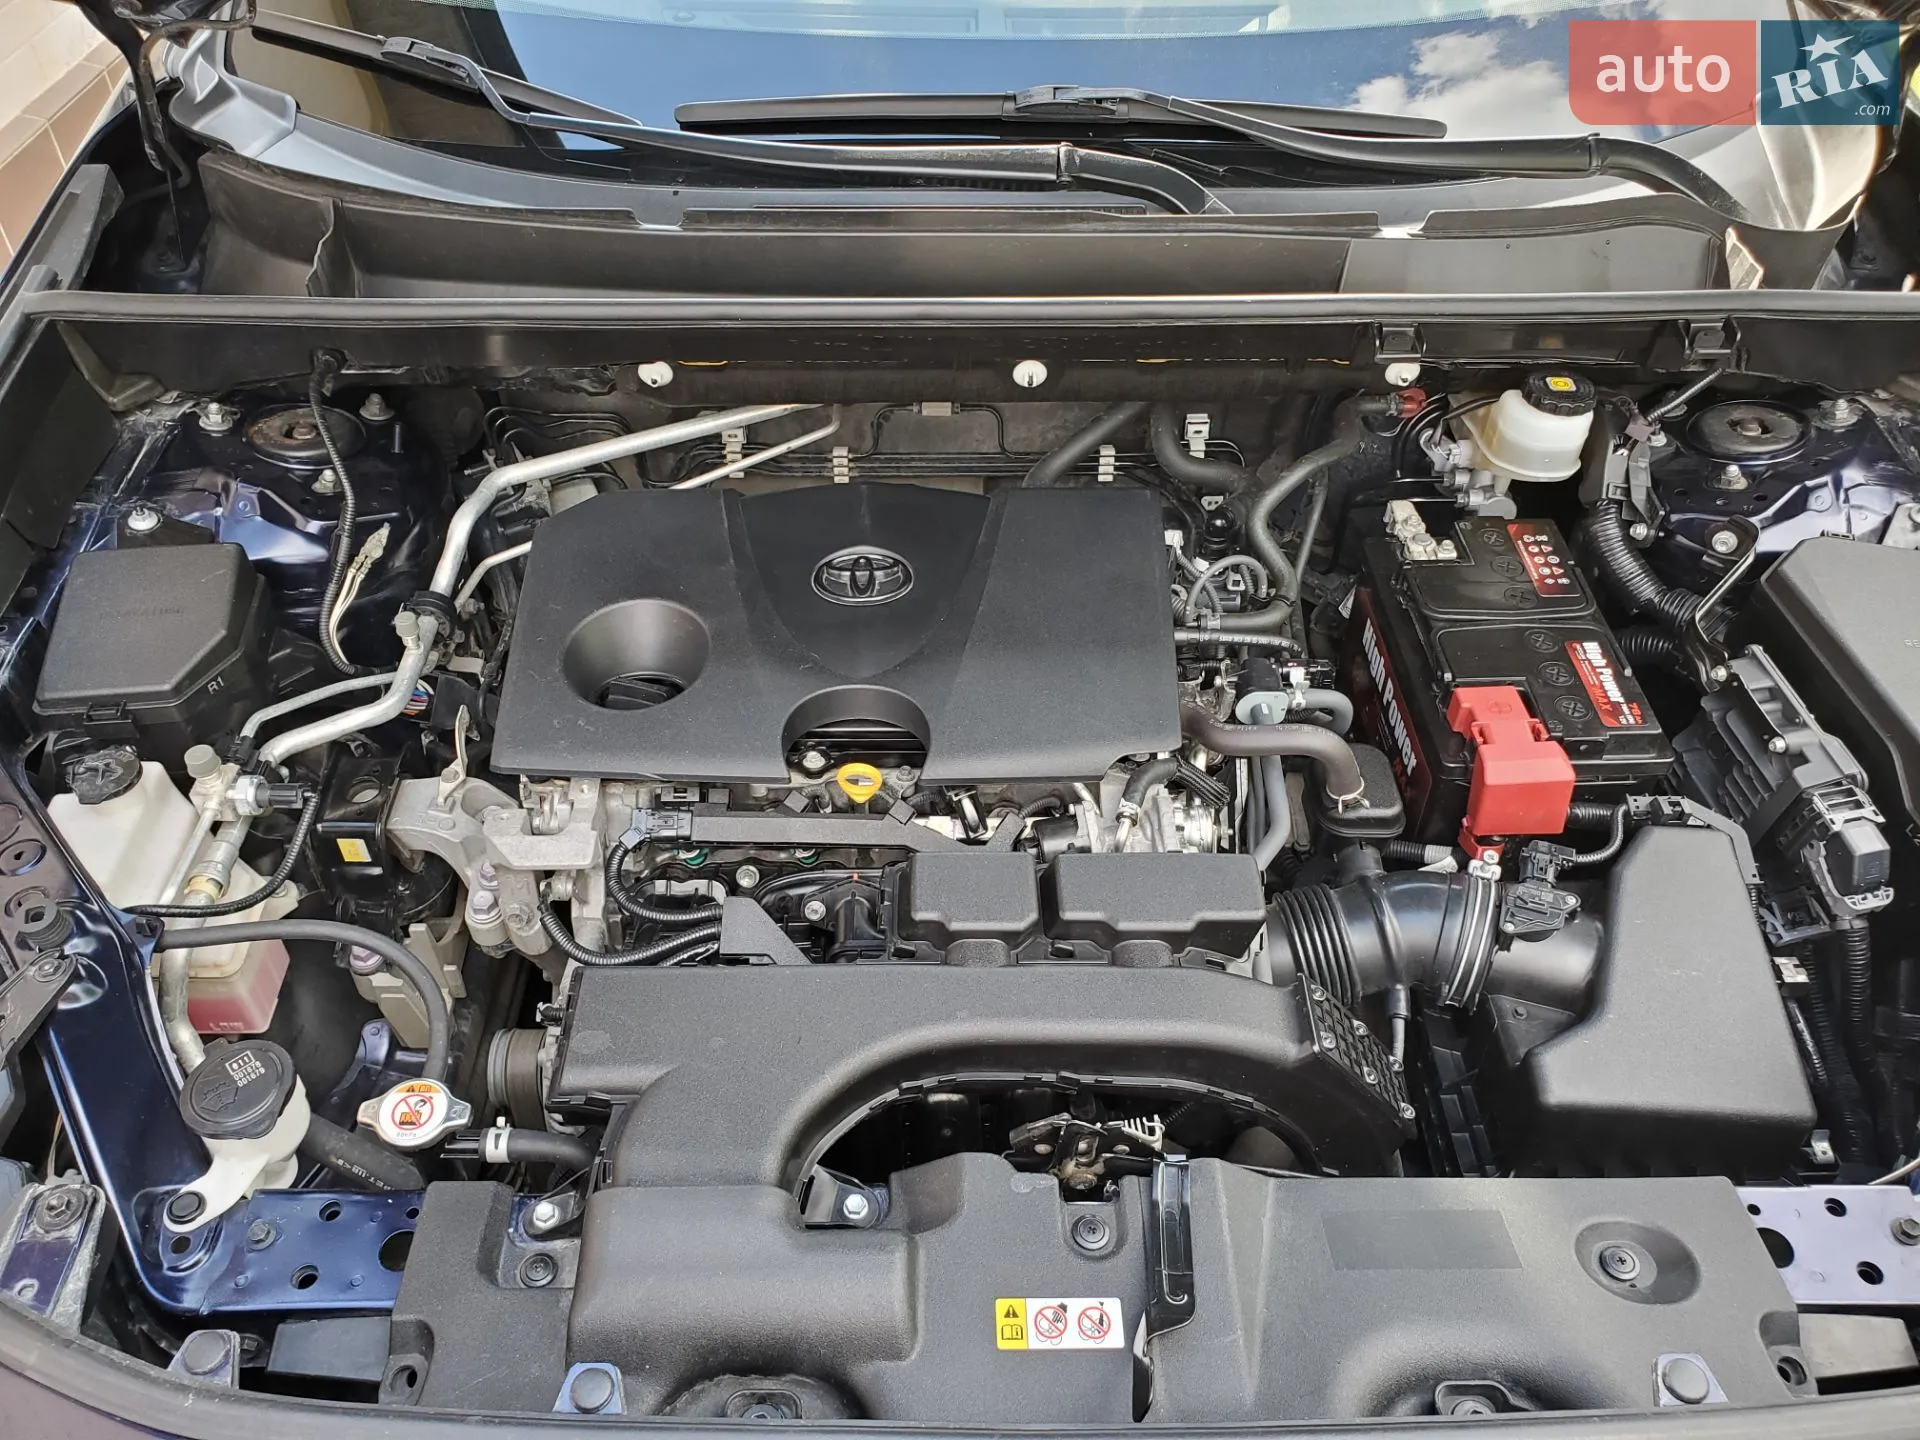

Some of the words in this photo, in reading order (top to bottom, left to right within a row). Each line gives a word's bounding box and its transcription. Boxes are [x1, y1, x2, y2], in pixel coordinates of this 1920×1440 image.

[207, 675, 225, 696] R1
[1581, 641, 1608, 667] High
[1596, 667, 1625, 703] Power
[1362, 617, 1387, 693] High
[1383, 677, 1417, 777] Power
[1591, 686, 1612, 712] MAX
